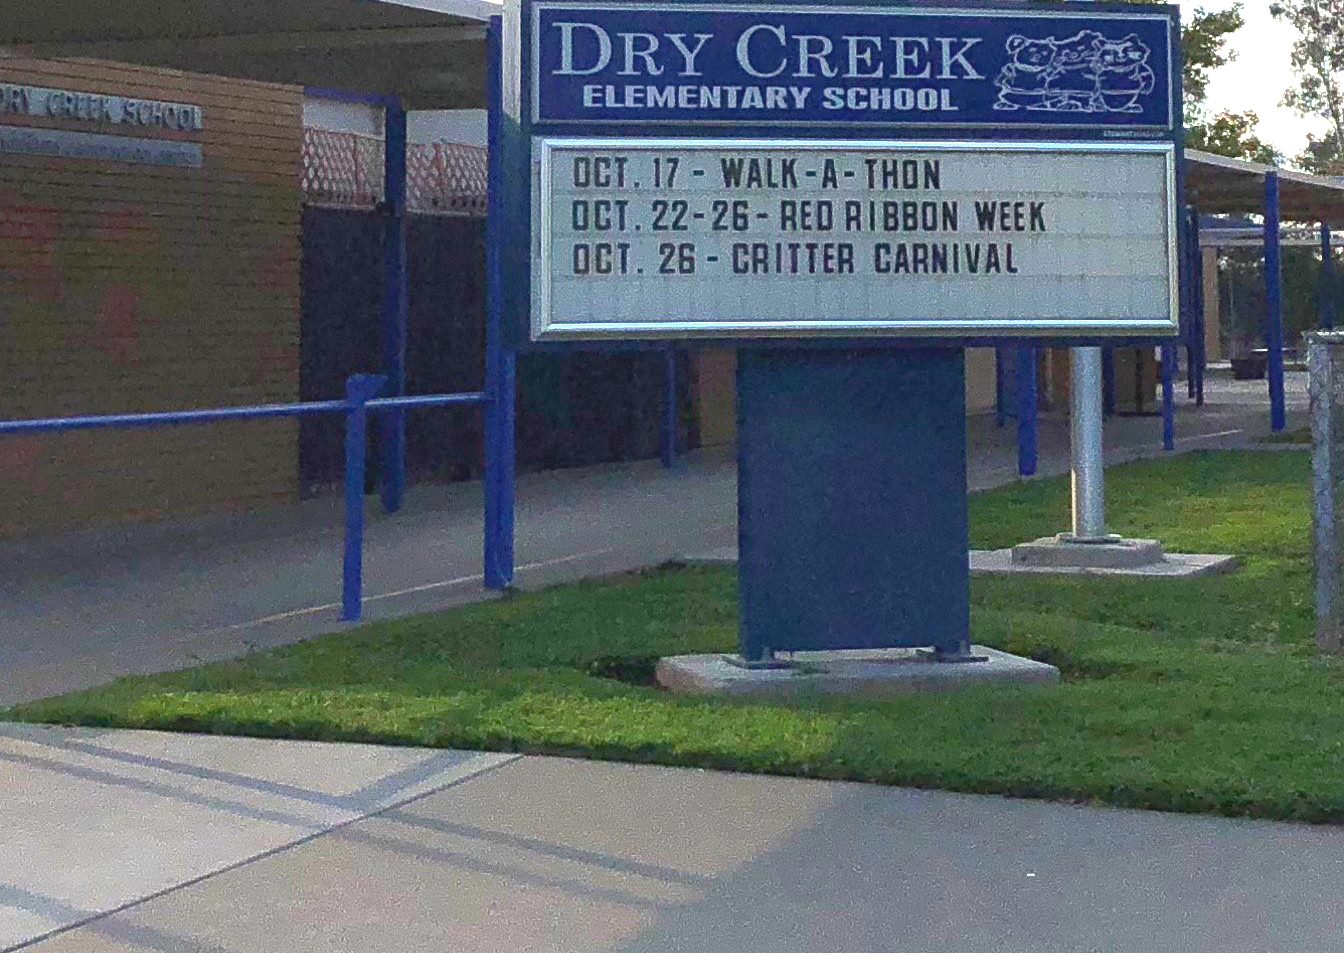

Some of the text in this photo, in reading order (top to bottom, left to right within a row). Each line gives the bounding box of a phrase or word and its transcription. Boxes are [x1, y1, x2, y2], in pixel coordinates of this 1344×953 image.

[552, 21, 985, 79] DRY CREEK
[47, 90, 116, 124] CREEK
[121, 98, 203, 131] SCHOOL
[583, 84, 959, 111] ELEMENTARY SCHOOL
[574, 156, 640, 188] OCT.
[654, 156, 679, 188] 17
[572, 199, 641, 231] OCT.
[780, 199, 834, 231] RED
[845, 200, 958, 231] RIBBON
[975, 201, 1045, 232] WEEK
[573, 242, 643, 274] OCT.
[658, 242, 696, 274] 26
[732, 242, 855, 274] CRITTER
[874, 242, 1018, 274] CARNIVAL
